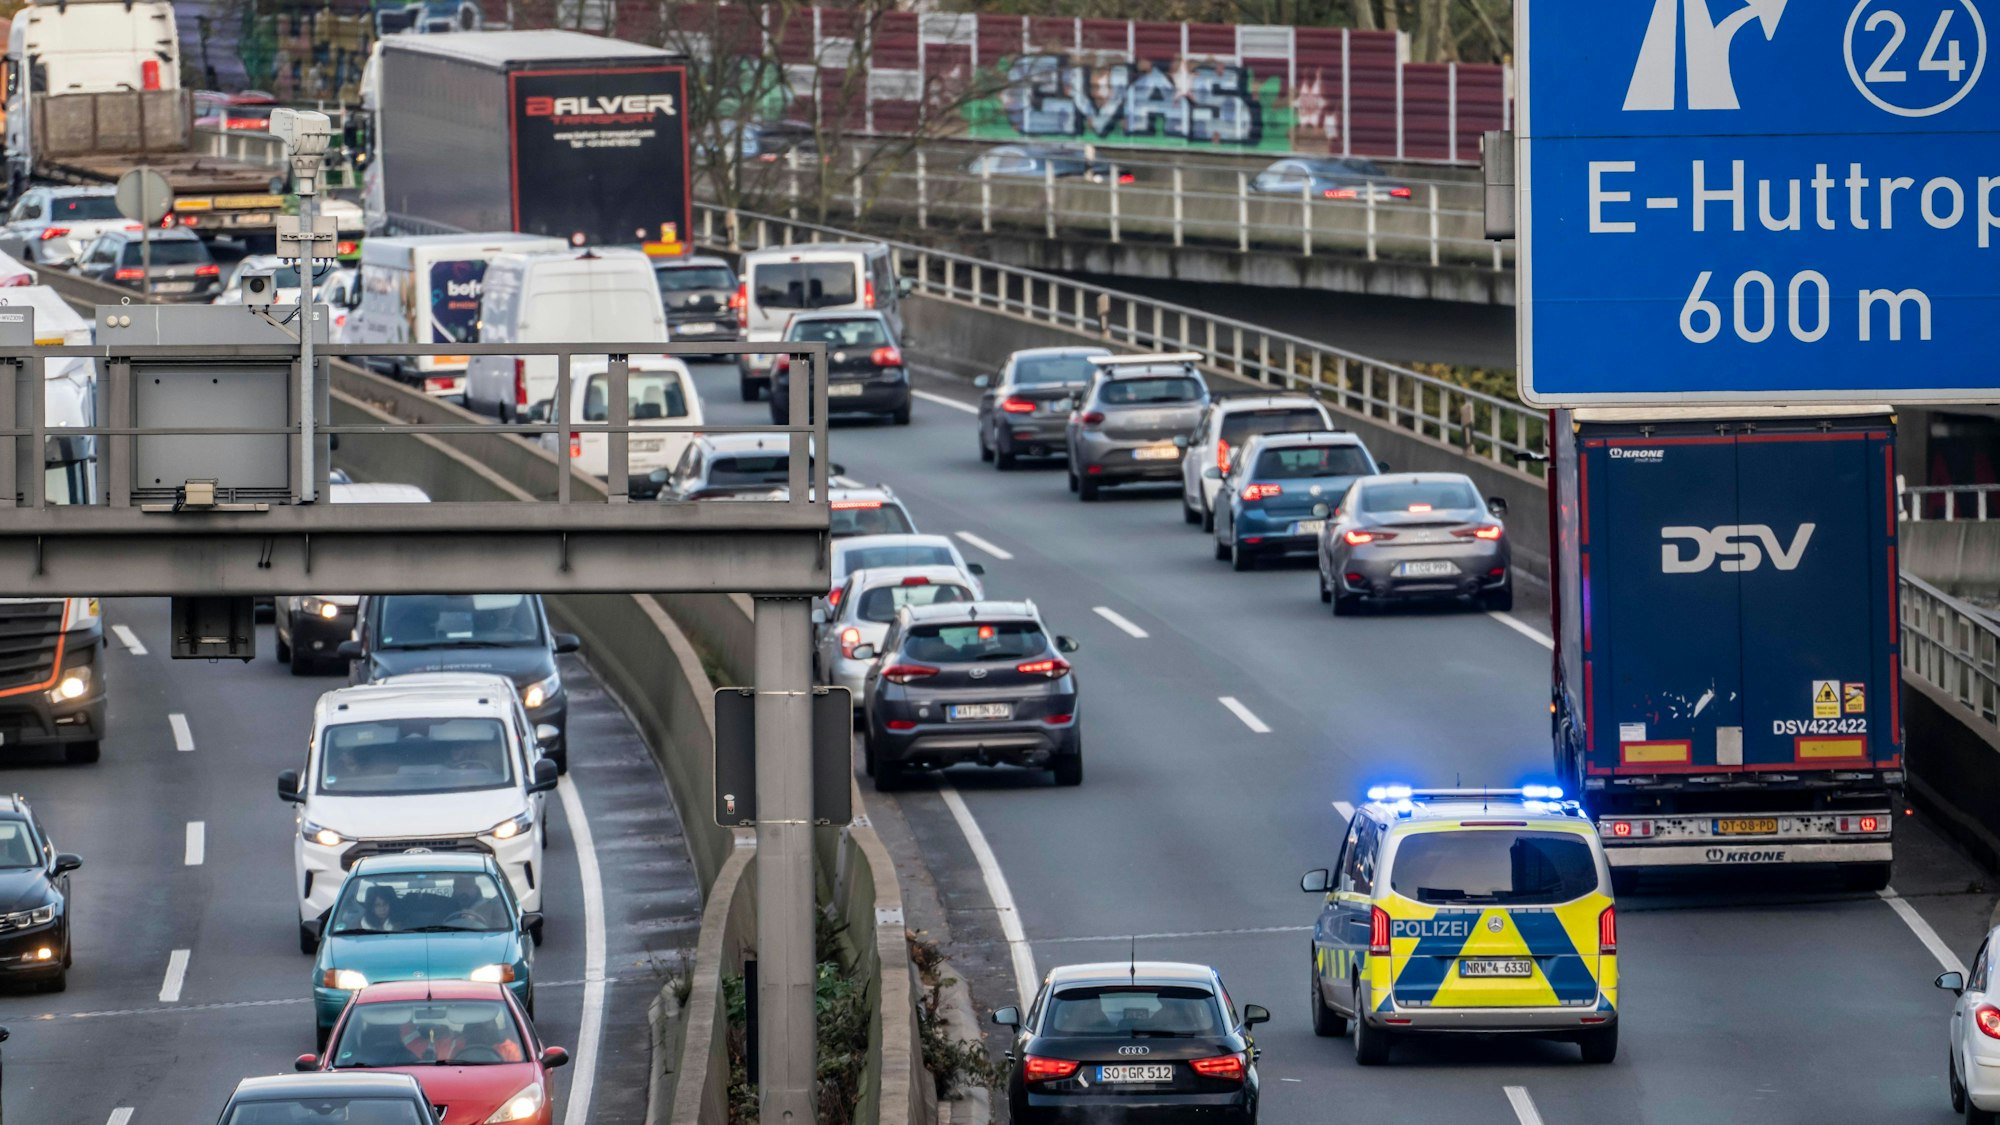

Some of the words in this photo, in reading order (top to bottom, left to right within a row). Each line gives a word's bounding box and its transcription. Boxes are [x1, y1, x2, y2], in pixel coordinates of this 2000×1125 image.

[1864, 9, 1966, 83] 24
[526, 94, 677, 116] BALVER
[1679, 269, 1830, 343] 600
[1858, 288, 1932, 342] m
[1623, 450, 1664, 458] KRONE
[1661, 523, 1816, 573] DSV
[1773, 719, 1867, 735] DSV422422
[1721, 819, 1774, 831] OT-08-PD
[1726, 851, 1786, 862] KRONE
[1393, 921, 1468, 936] POLIZEI
[1466, 962, 1487, 973] NRW
[1103, 1067, 1120, 1079] SO
[1128, 1067, 1145, 1079] GR
[1147, 1066, 1171, 1079] 512
